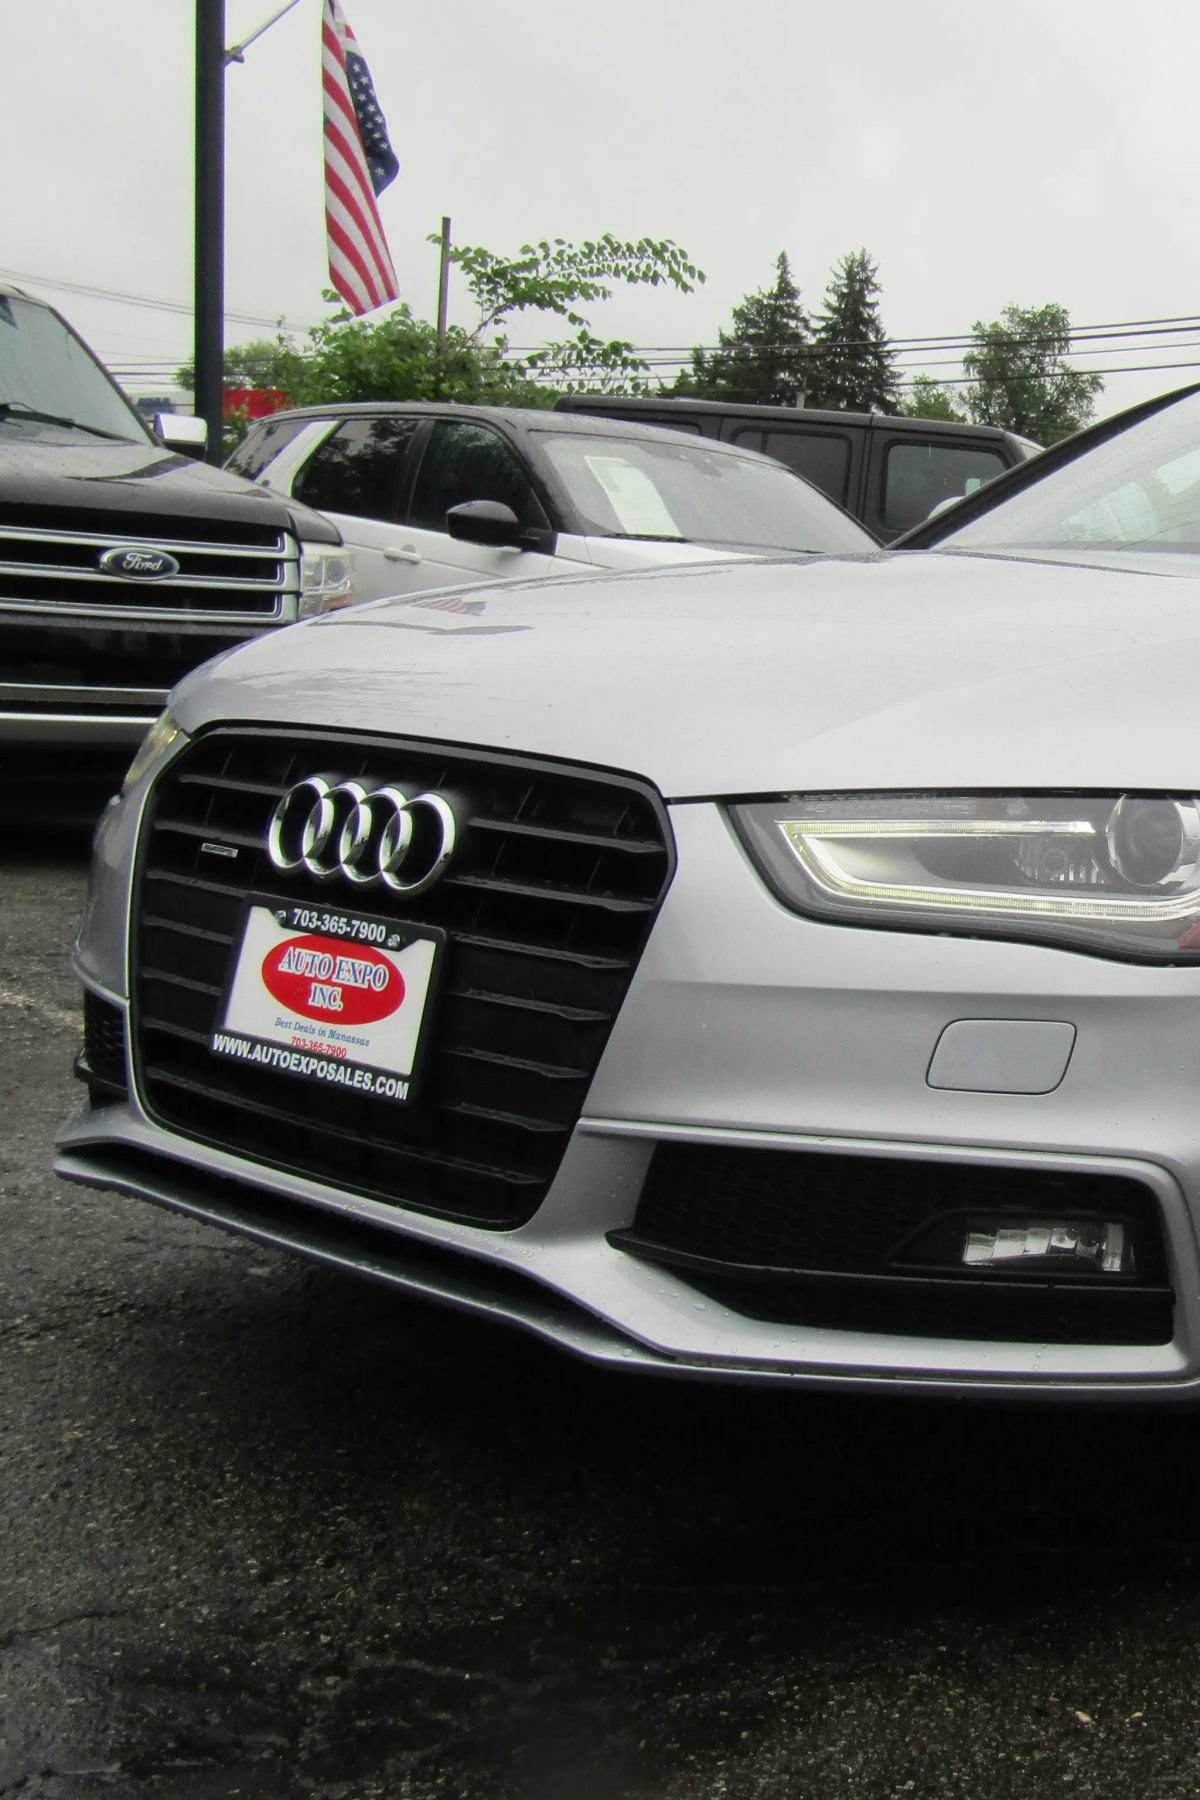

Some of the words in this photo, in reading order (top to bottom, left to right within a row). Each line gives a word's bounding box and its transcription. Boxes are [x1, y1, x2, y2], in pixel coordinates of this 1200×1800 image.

[122, 552, 164, 571] Ford
[293, 908, 387, 943] 703-365-7900
[279, 947, 333, 980] AUTO
[334, 957, 388, 991] EXPO
[309, 984, 343, 1011] INC.
[275, 1016, 293, 1030] Best
[293, 1021, 316, 1035] Deals
[317, 1026, 326, 1037] in
[328, 1029, 370, 1047] Manassas
[291, 1036, 347, 1058] 703-365-7900
[213, 1033, 409, 1100] WWW.AUTOEXPOSALES.COM
